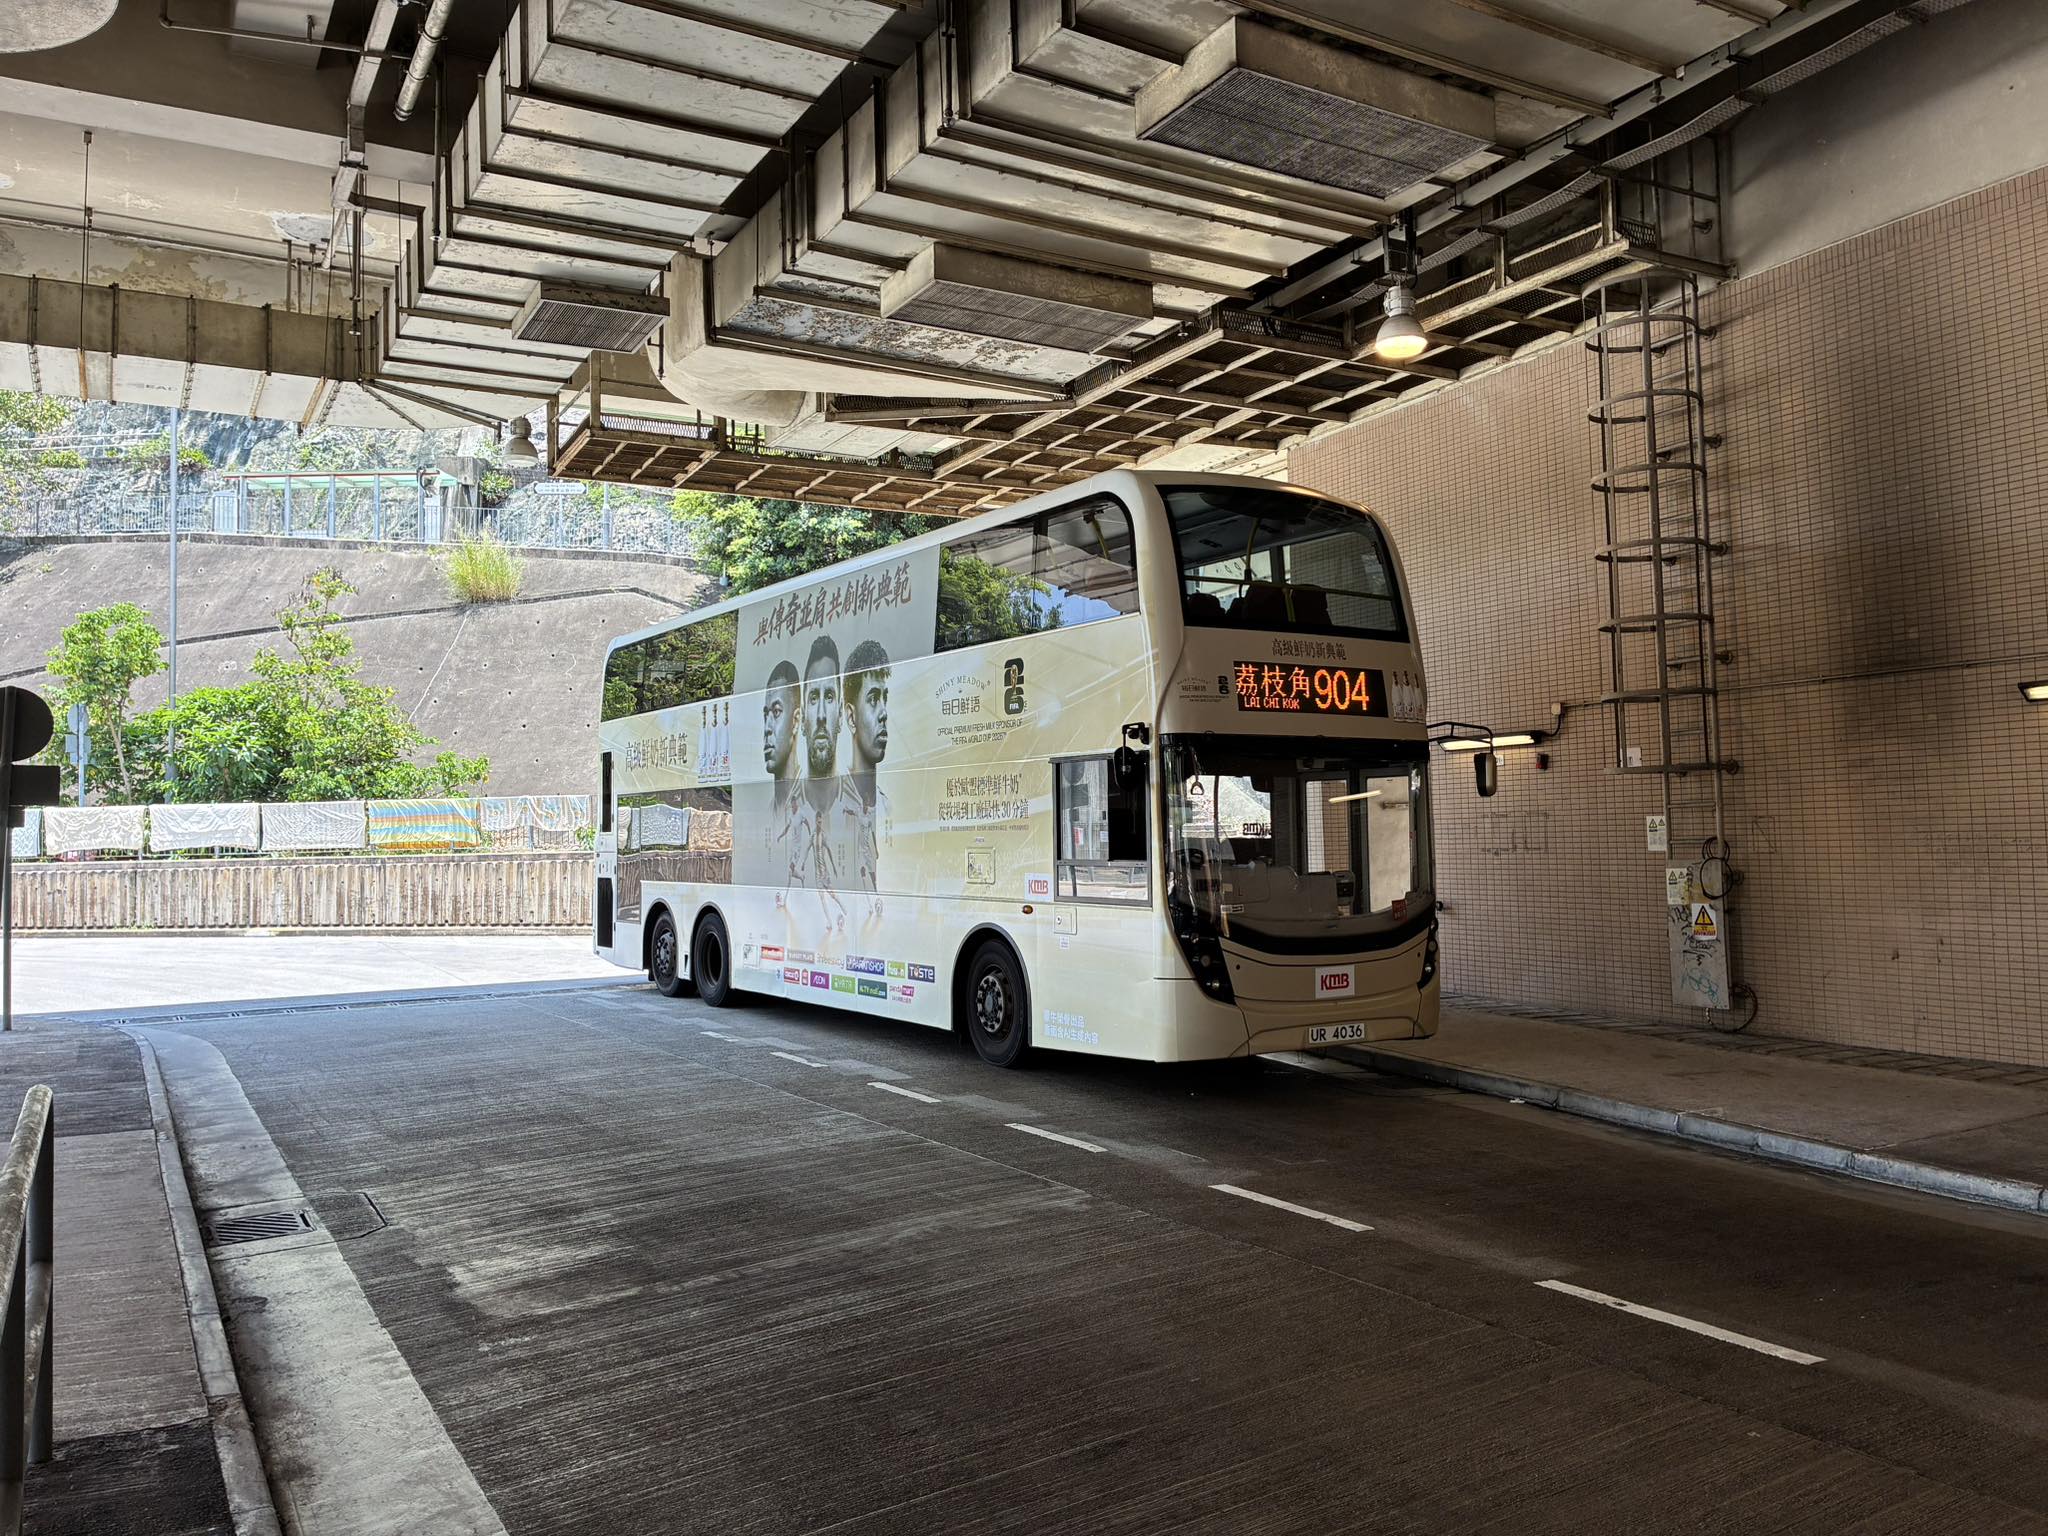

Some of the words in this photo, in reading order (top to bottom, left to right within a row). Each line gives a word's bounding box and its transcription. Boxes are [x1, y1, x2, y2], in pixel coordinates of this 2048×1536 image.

[753, 560, 912, 646] 與傳奇並肩共創新典範
[1272, 639, 1346, 660] 高級鮮奶新典範
[936, 678, 955, 698] SHINY
[1235, 664, 1310, 698] 荔枝角
[1314, 669, 1370, 710] 904
[942, 696, 980, 715] 每日鮮語
[1244, 697, 1260, 708] LAI
[1263, 698, 1280, 709] CHI
[1283, 698, 1300, 710] KOK
[625, 733, 688, 773] 高級鮮奶新典範
[1028, 879, 1049, 894] KMB
[1320, 973, 1350, 991] KMB
[1310, 1027, 1326, 1042] UR
[1332, 1024, 1362, 1039] 4036
